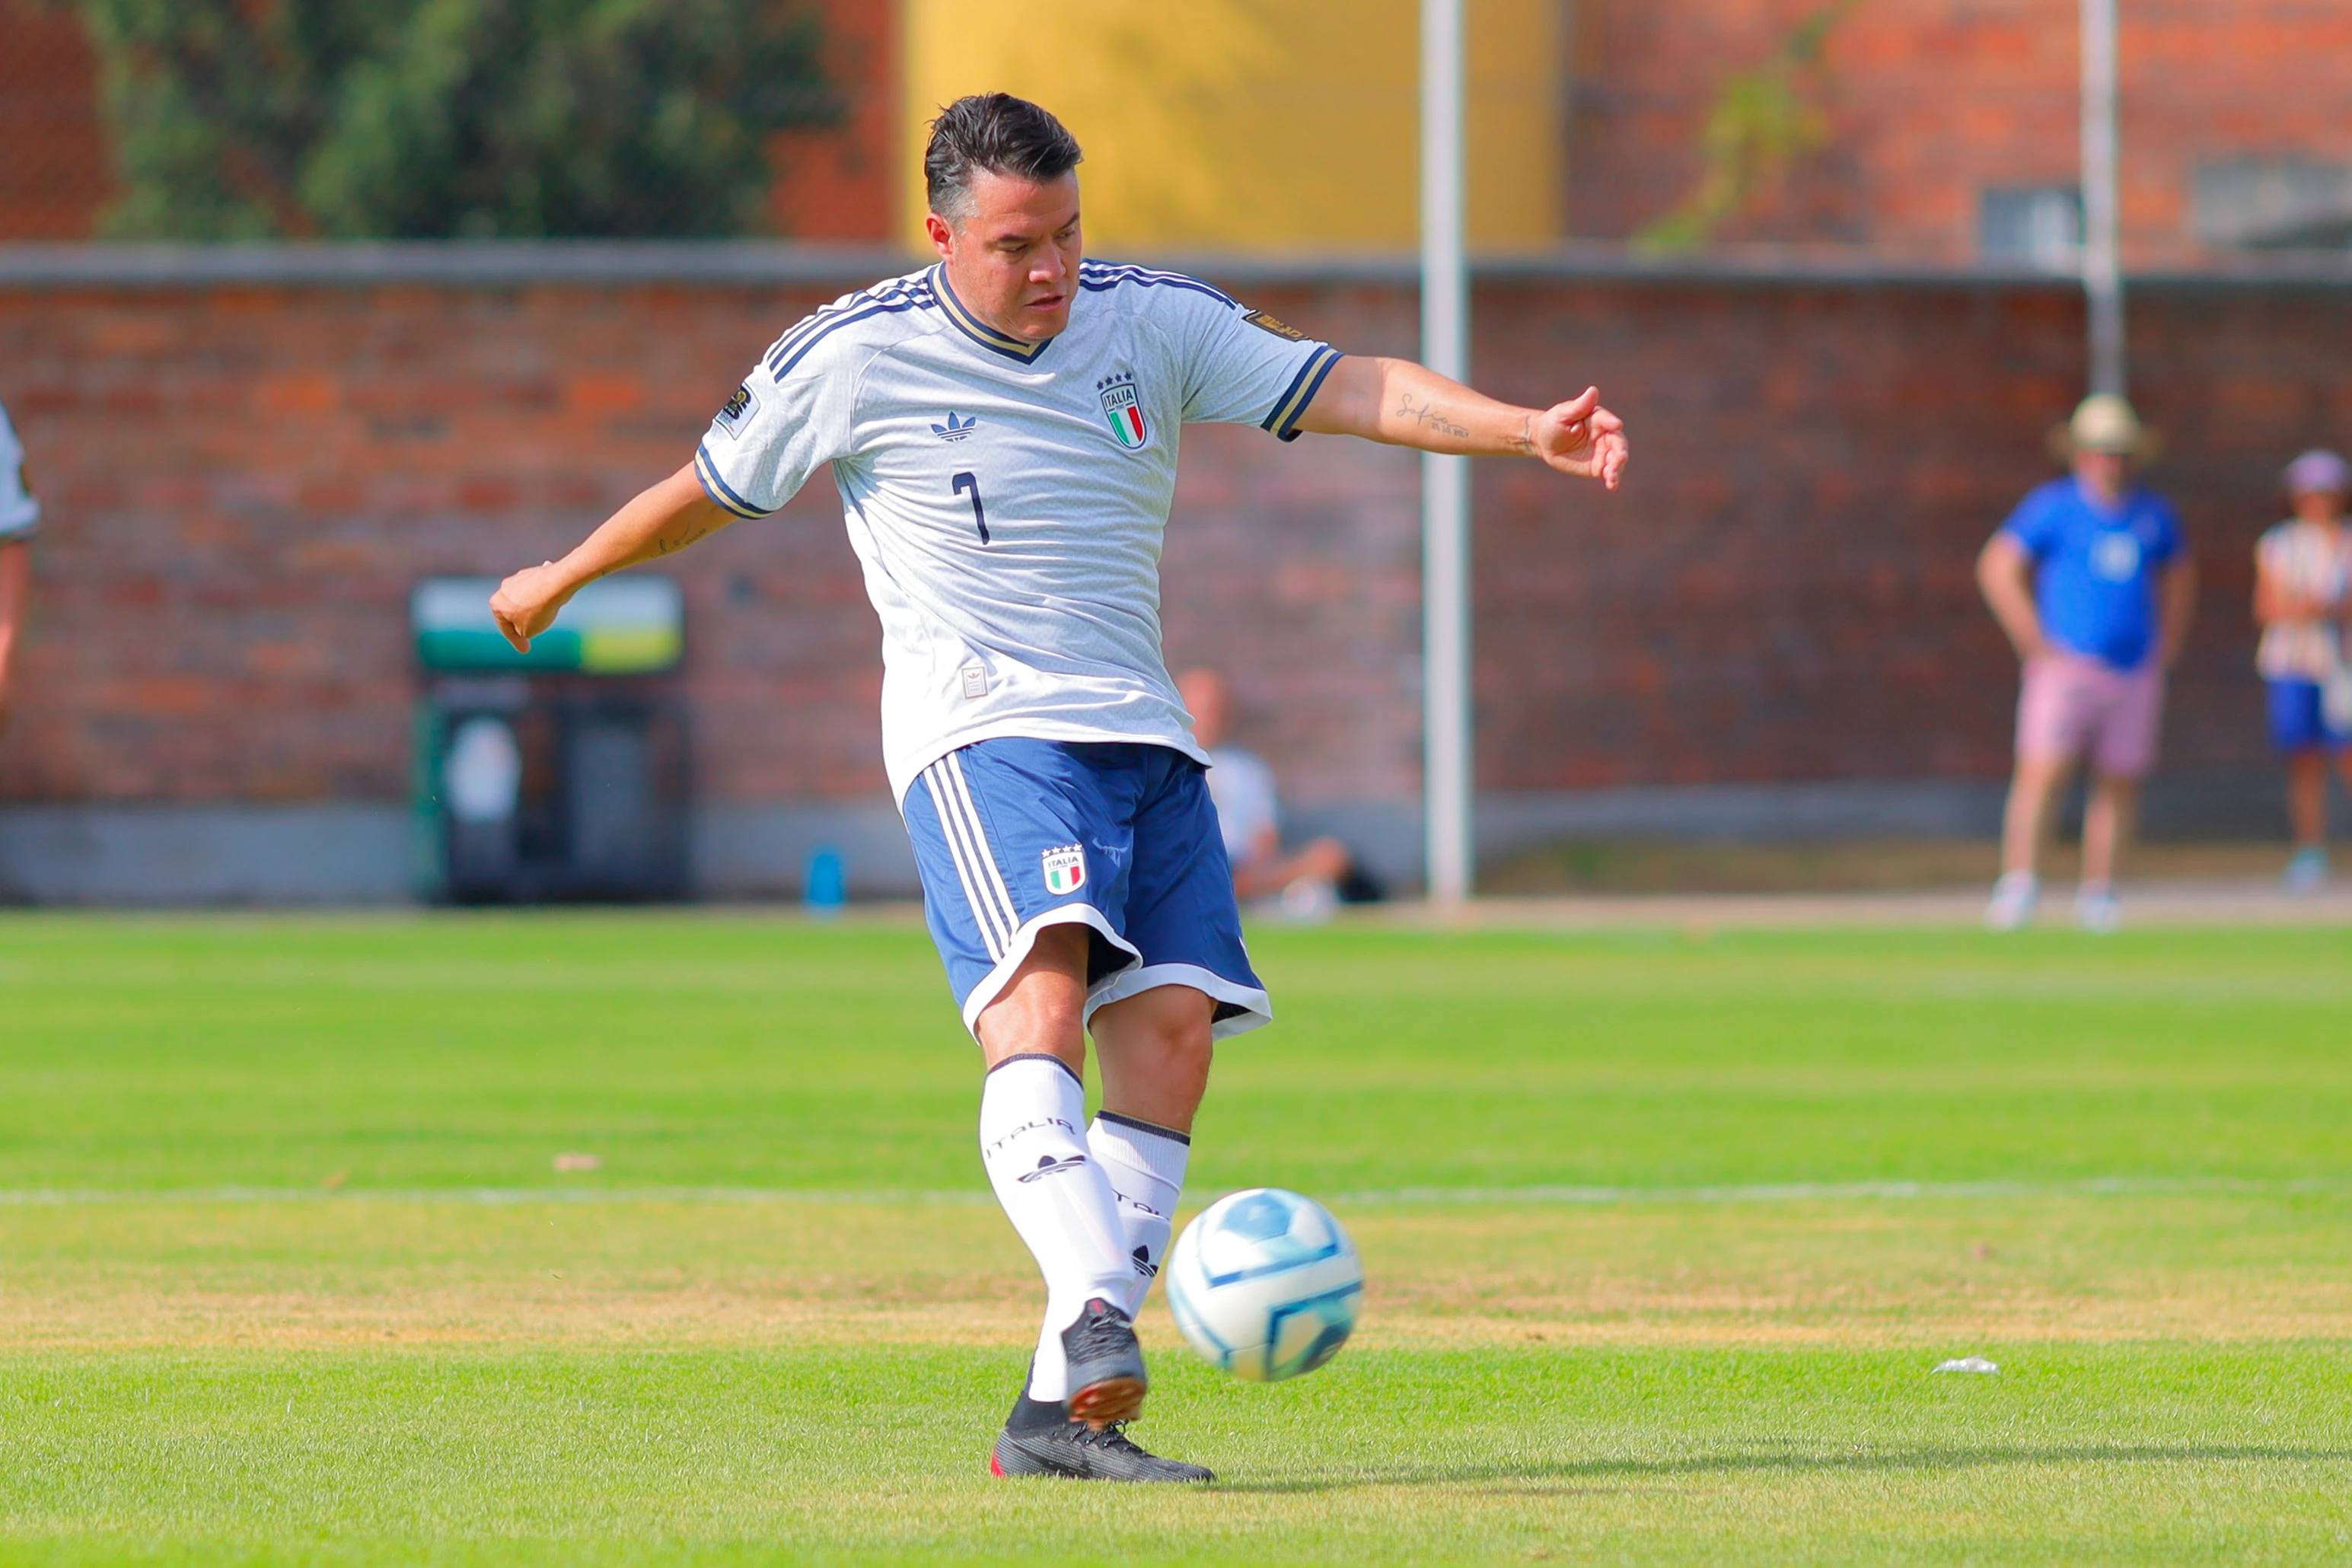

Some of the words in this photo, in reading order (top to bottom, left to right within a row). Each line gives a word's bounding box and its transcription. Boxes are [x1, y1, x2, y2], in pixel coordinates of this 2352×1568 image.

[1103, 388, 1134, 408] ITALIA
[952, 471, 990, 545] 7
[1048, 856, 1079, 868] ITALIA
